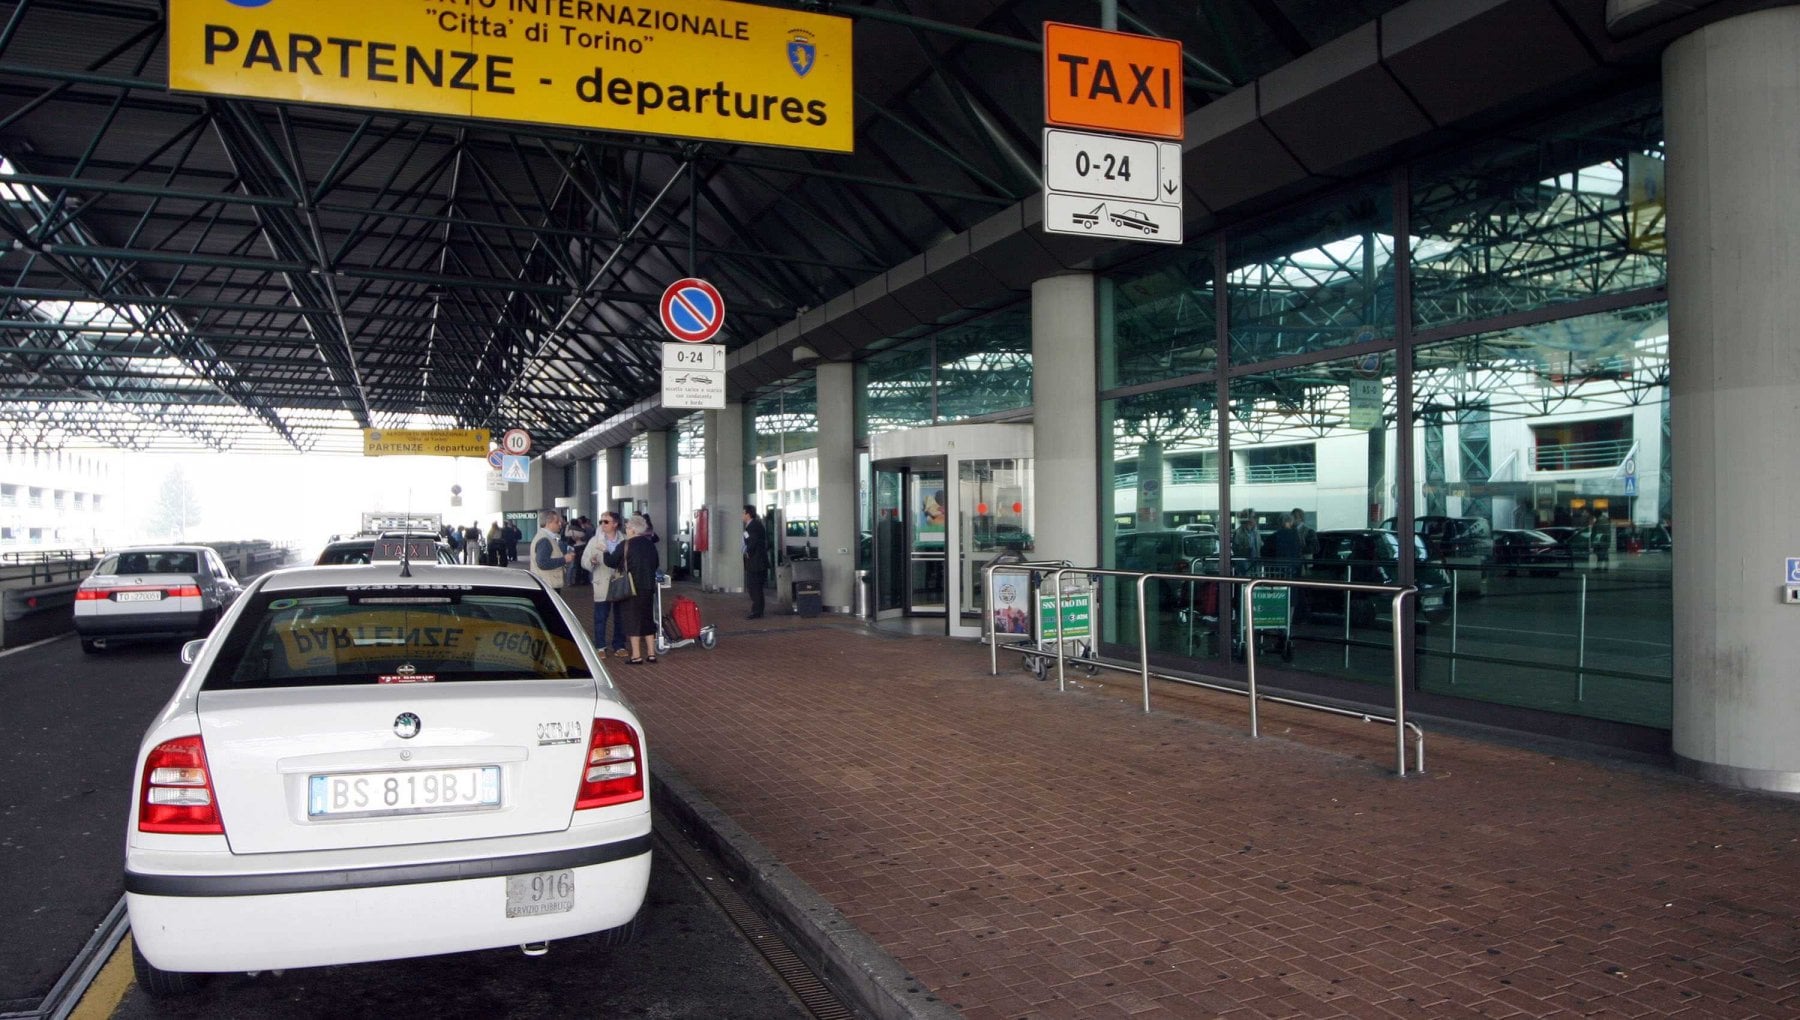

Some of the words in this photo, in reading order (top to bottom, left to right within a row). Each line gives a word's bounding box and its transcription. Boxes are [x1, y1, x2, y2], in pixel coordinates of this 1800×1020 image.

[508, 0, 750, 41] INTERNAZIONALE
[525, 22, 548, 42] di
[559, 25, 654, 54] Torino"
[204, 24, 516, 94] PARTENZE
[575, 67, 828, 126] departures
[1058, 53, 1171, 109] TAXI
[1075, 150, 1131, 182] 0-24
[677, 351, 703, 363] 0-24
[369, 443, 423, 451] PARTENZE
[434, 443, 485, 452] departures
[511, 436, 524, 448] 10
[382, 543, 430, 557] TAXI
[332, 778, 369, 810] BS
[383, 772, 477, 807] 819BJ
[531, 872, 569, 902] 916
